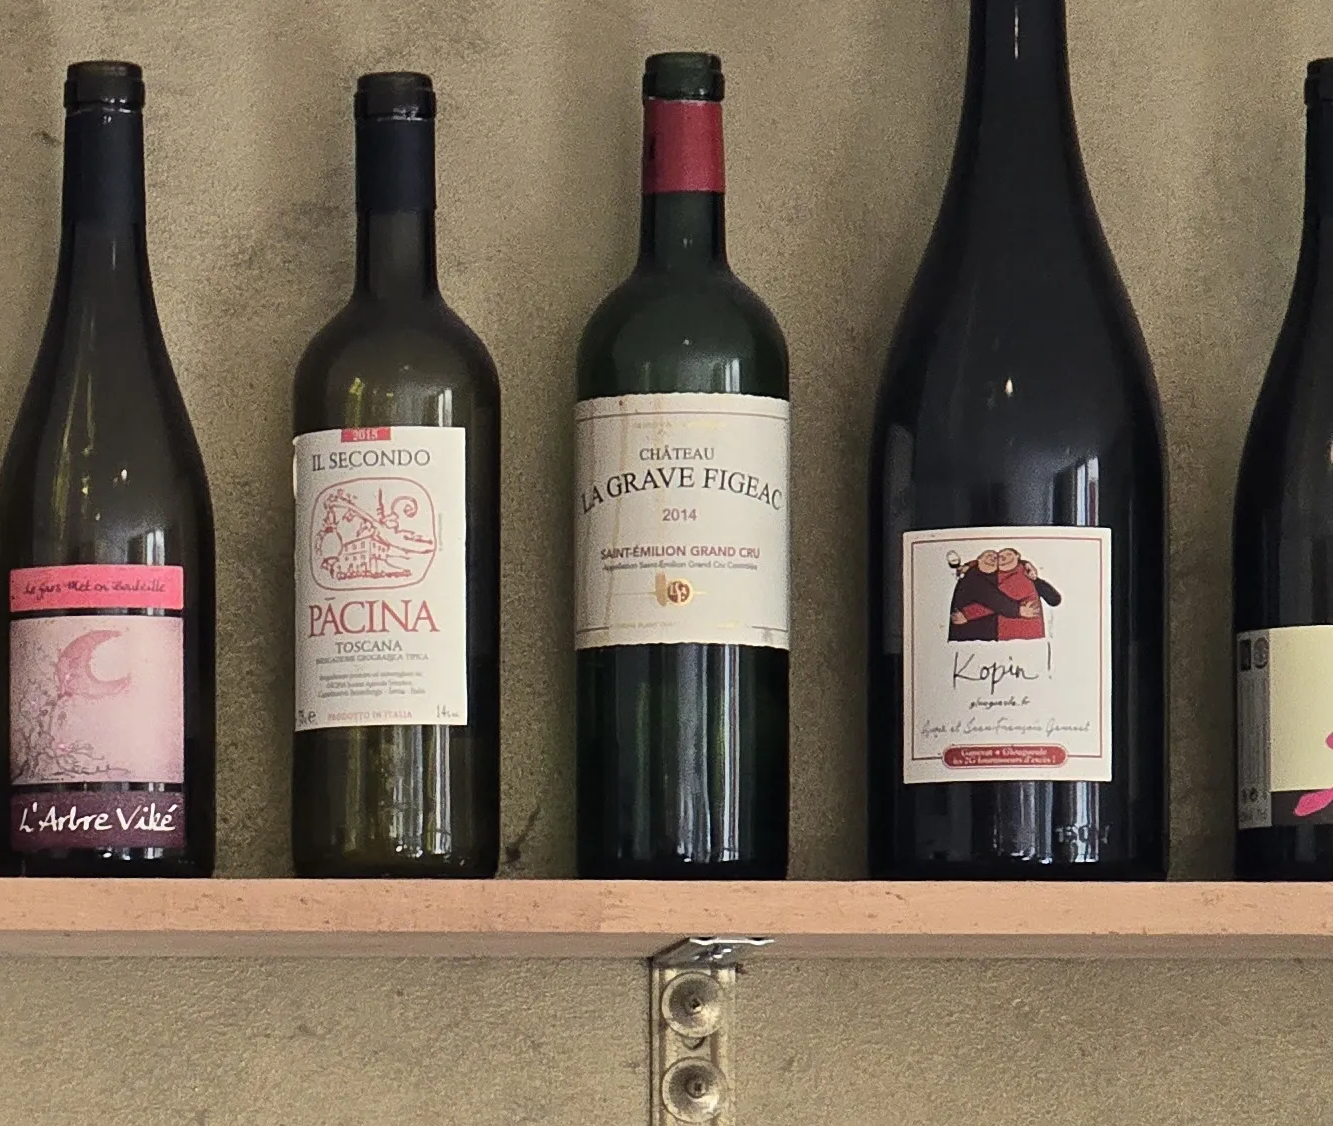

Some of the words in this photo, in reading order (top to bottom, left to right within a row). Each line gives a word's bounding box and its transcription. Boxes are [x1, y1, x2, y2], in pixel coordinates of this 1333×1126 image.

[312, 453, 326, 471] IL
[329, 449, 431, 469] SECONDO
[640, 445, 715, 461] CHÂTEAU
[581, 485, 604, 514] LA
[606, 467, 695, 498] GRAVE
[702, 467, 783, 511] FIGEAC
[662, 508, 698, 522] 2014
[600, 545, 686, 560] SAINT-ÉMILION
[691, 546, 736, 558] GRAND
[739, 548, 761, 559] CRU
[335, 640, 403, 654] TOSCANA
[19, 802, 113, 832] L'Arbre
[115, 802, 177, 832] Viké
